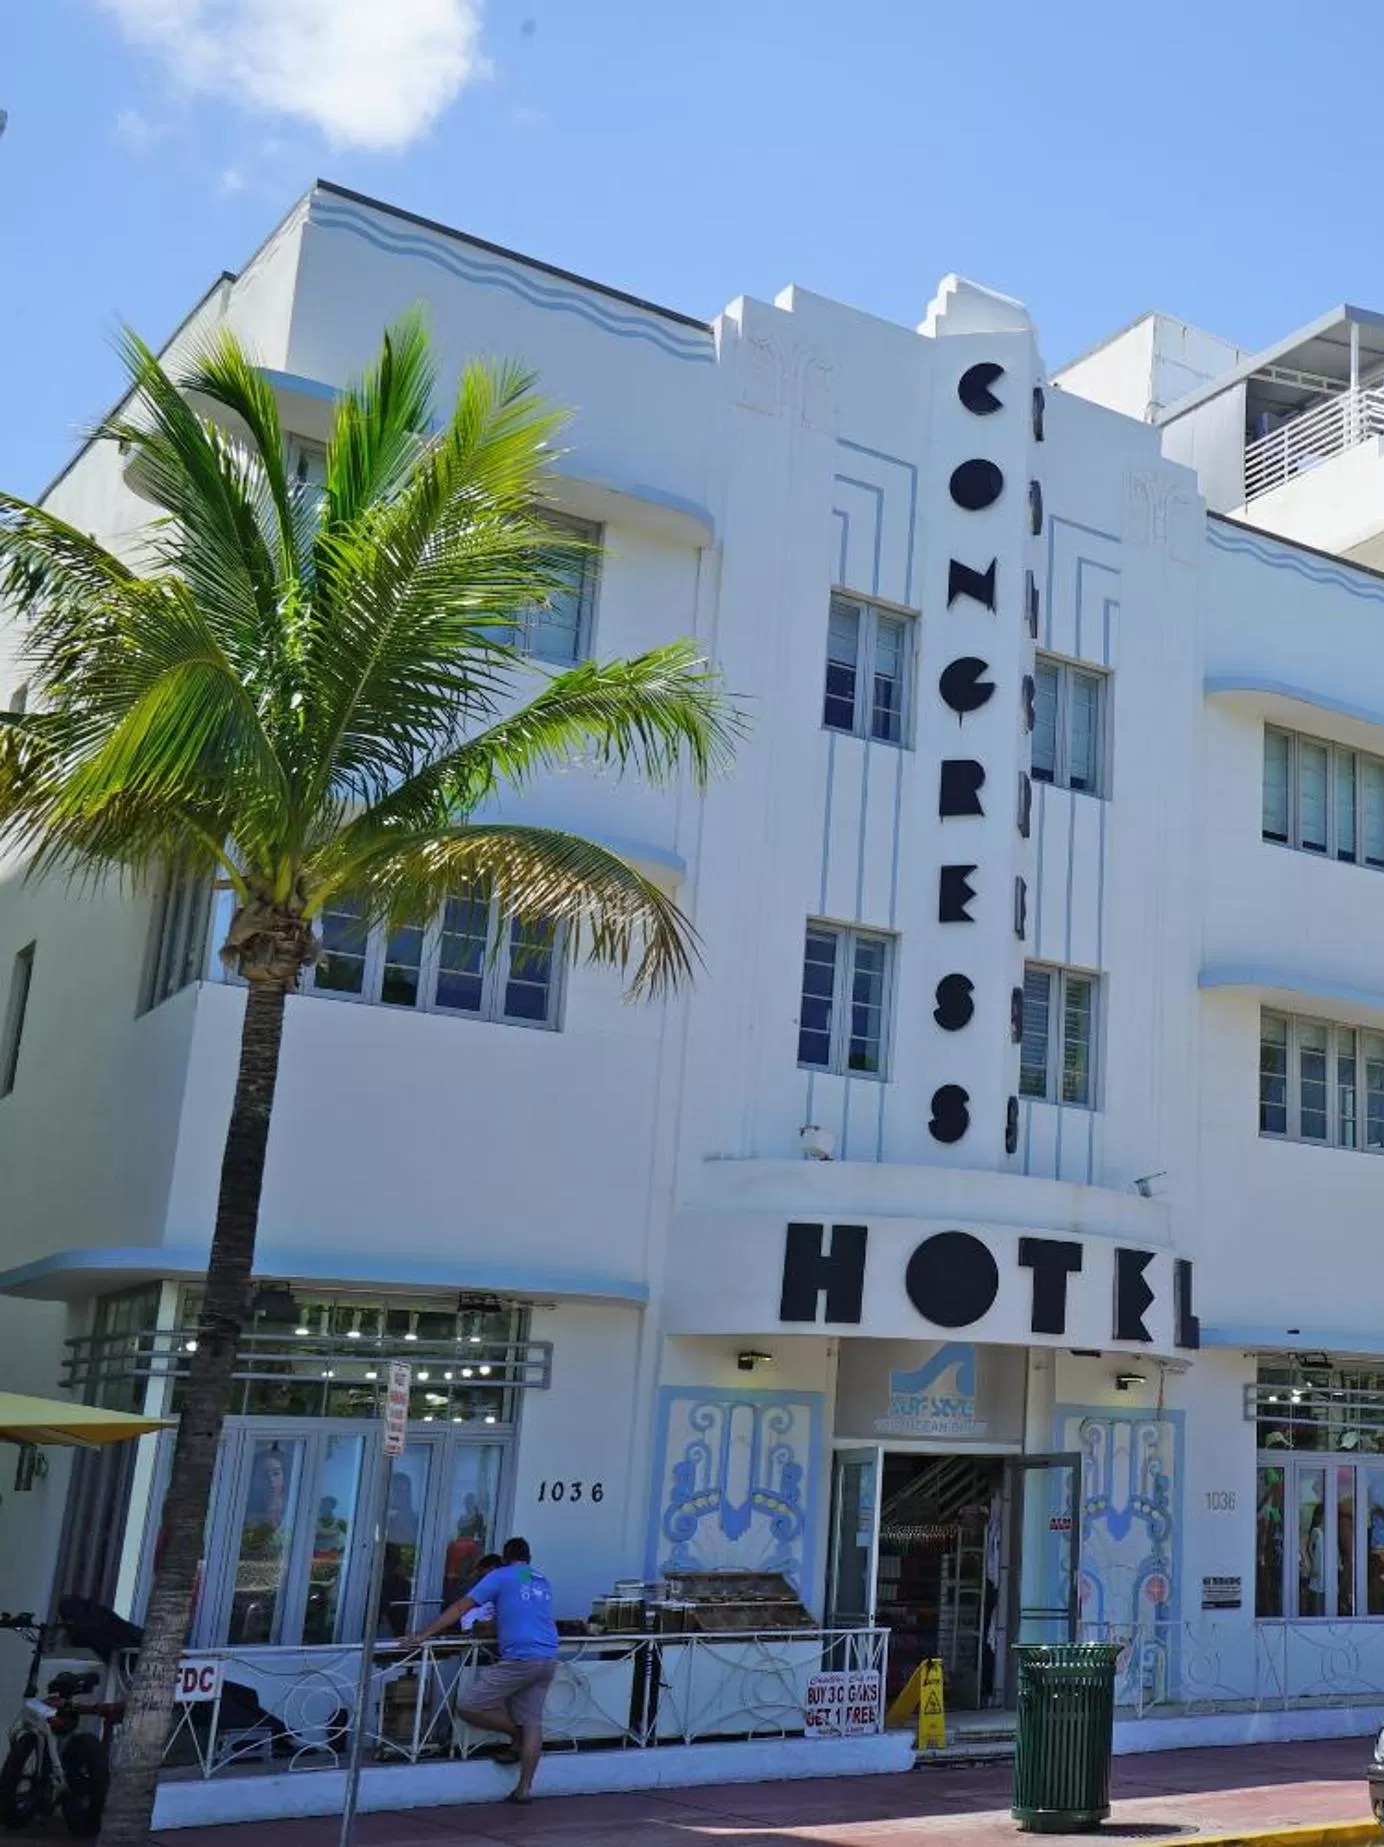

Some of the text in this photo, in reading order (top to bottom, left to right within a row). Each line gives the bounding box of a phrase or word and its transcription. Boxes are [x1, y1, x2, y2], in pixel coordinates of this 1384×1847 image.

[927, 361, 1005, 1145] CONGRESS
[779, 1222, 1201, 1350] HOTEL
[537, 1480, 605, 1503] 1036
[1204, 1490, 1237, 1511] 1036
